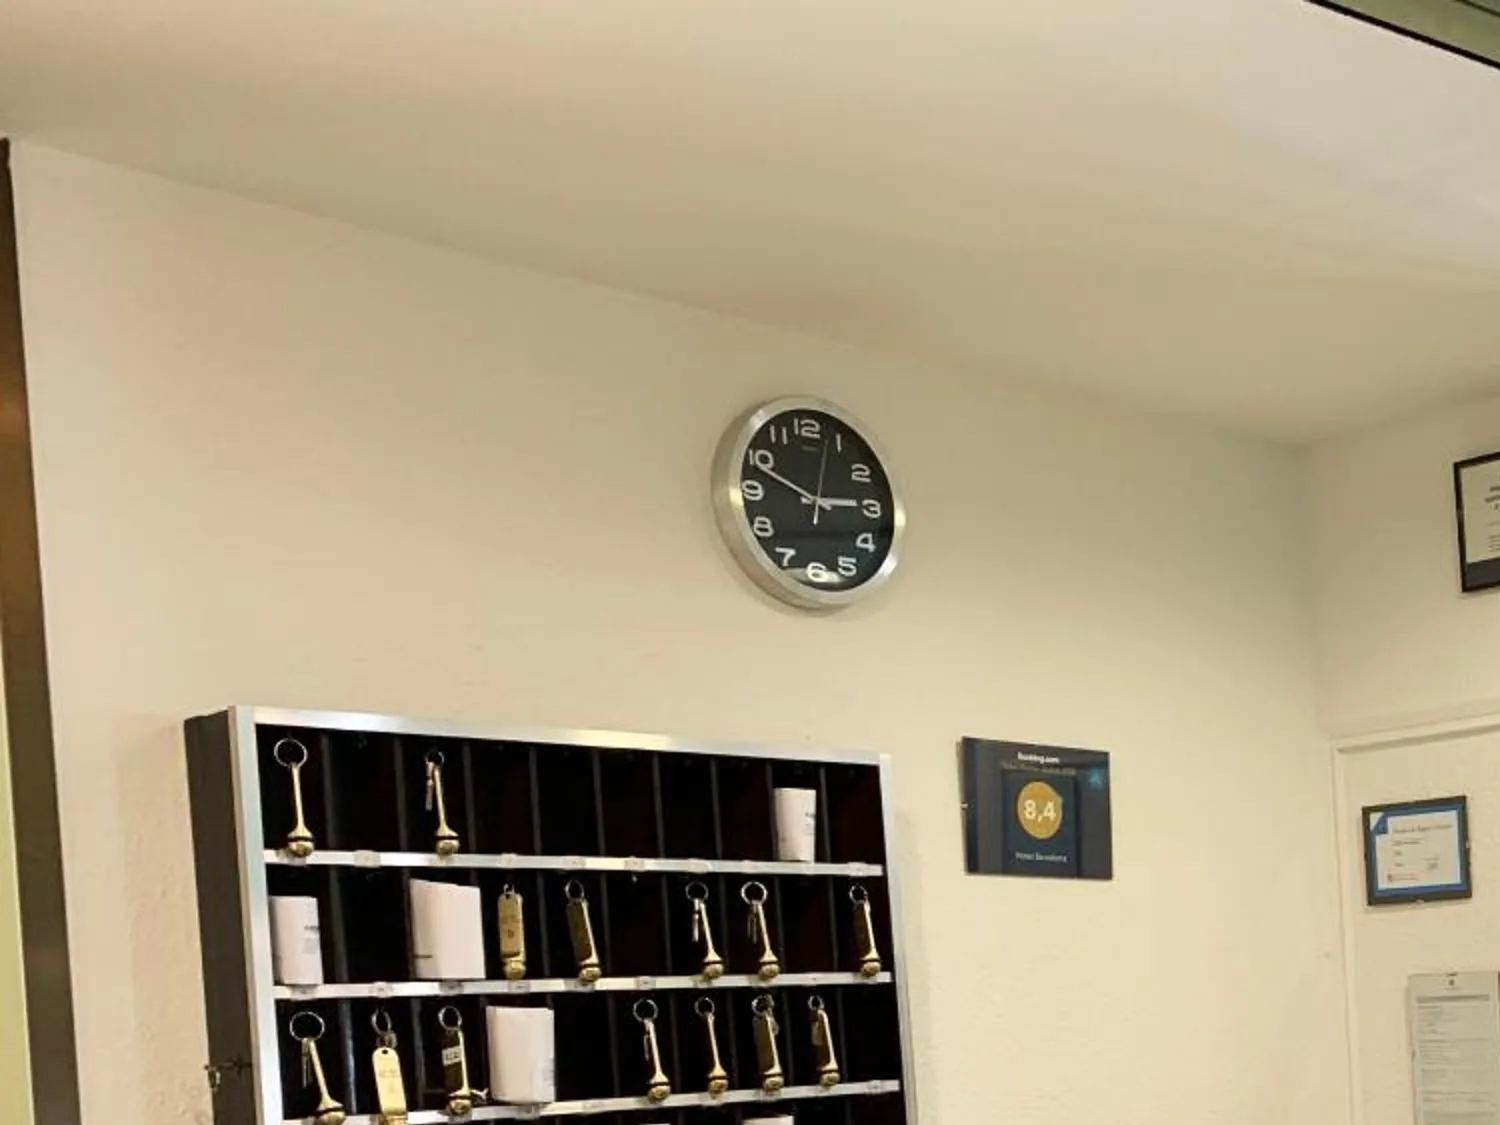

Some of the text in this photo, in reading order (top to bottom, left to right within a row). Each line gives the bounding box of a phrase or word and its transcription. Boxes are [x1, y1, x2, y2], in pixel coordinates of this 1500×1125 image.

[769, 424, 789, 445] 11
[793, 417, 821, 439] 12
[835, 433, 843, 453] 1
[748, 449, 774, 470] 10
[851, 464, 872, 483] 2
[741, 480, 765, 501] 9
[861, 499, 882, 519] 3
[753, 516, 774, 537] 8
[855, 533, 877, 553] 4
[775, 547, 797, 567] 7
[837, 556, 857, 577] 5
[806, 562, 828, 583] 6
